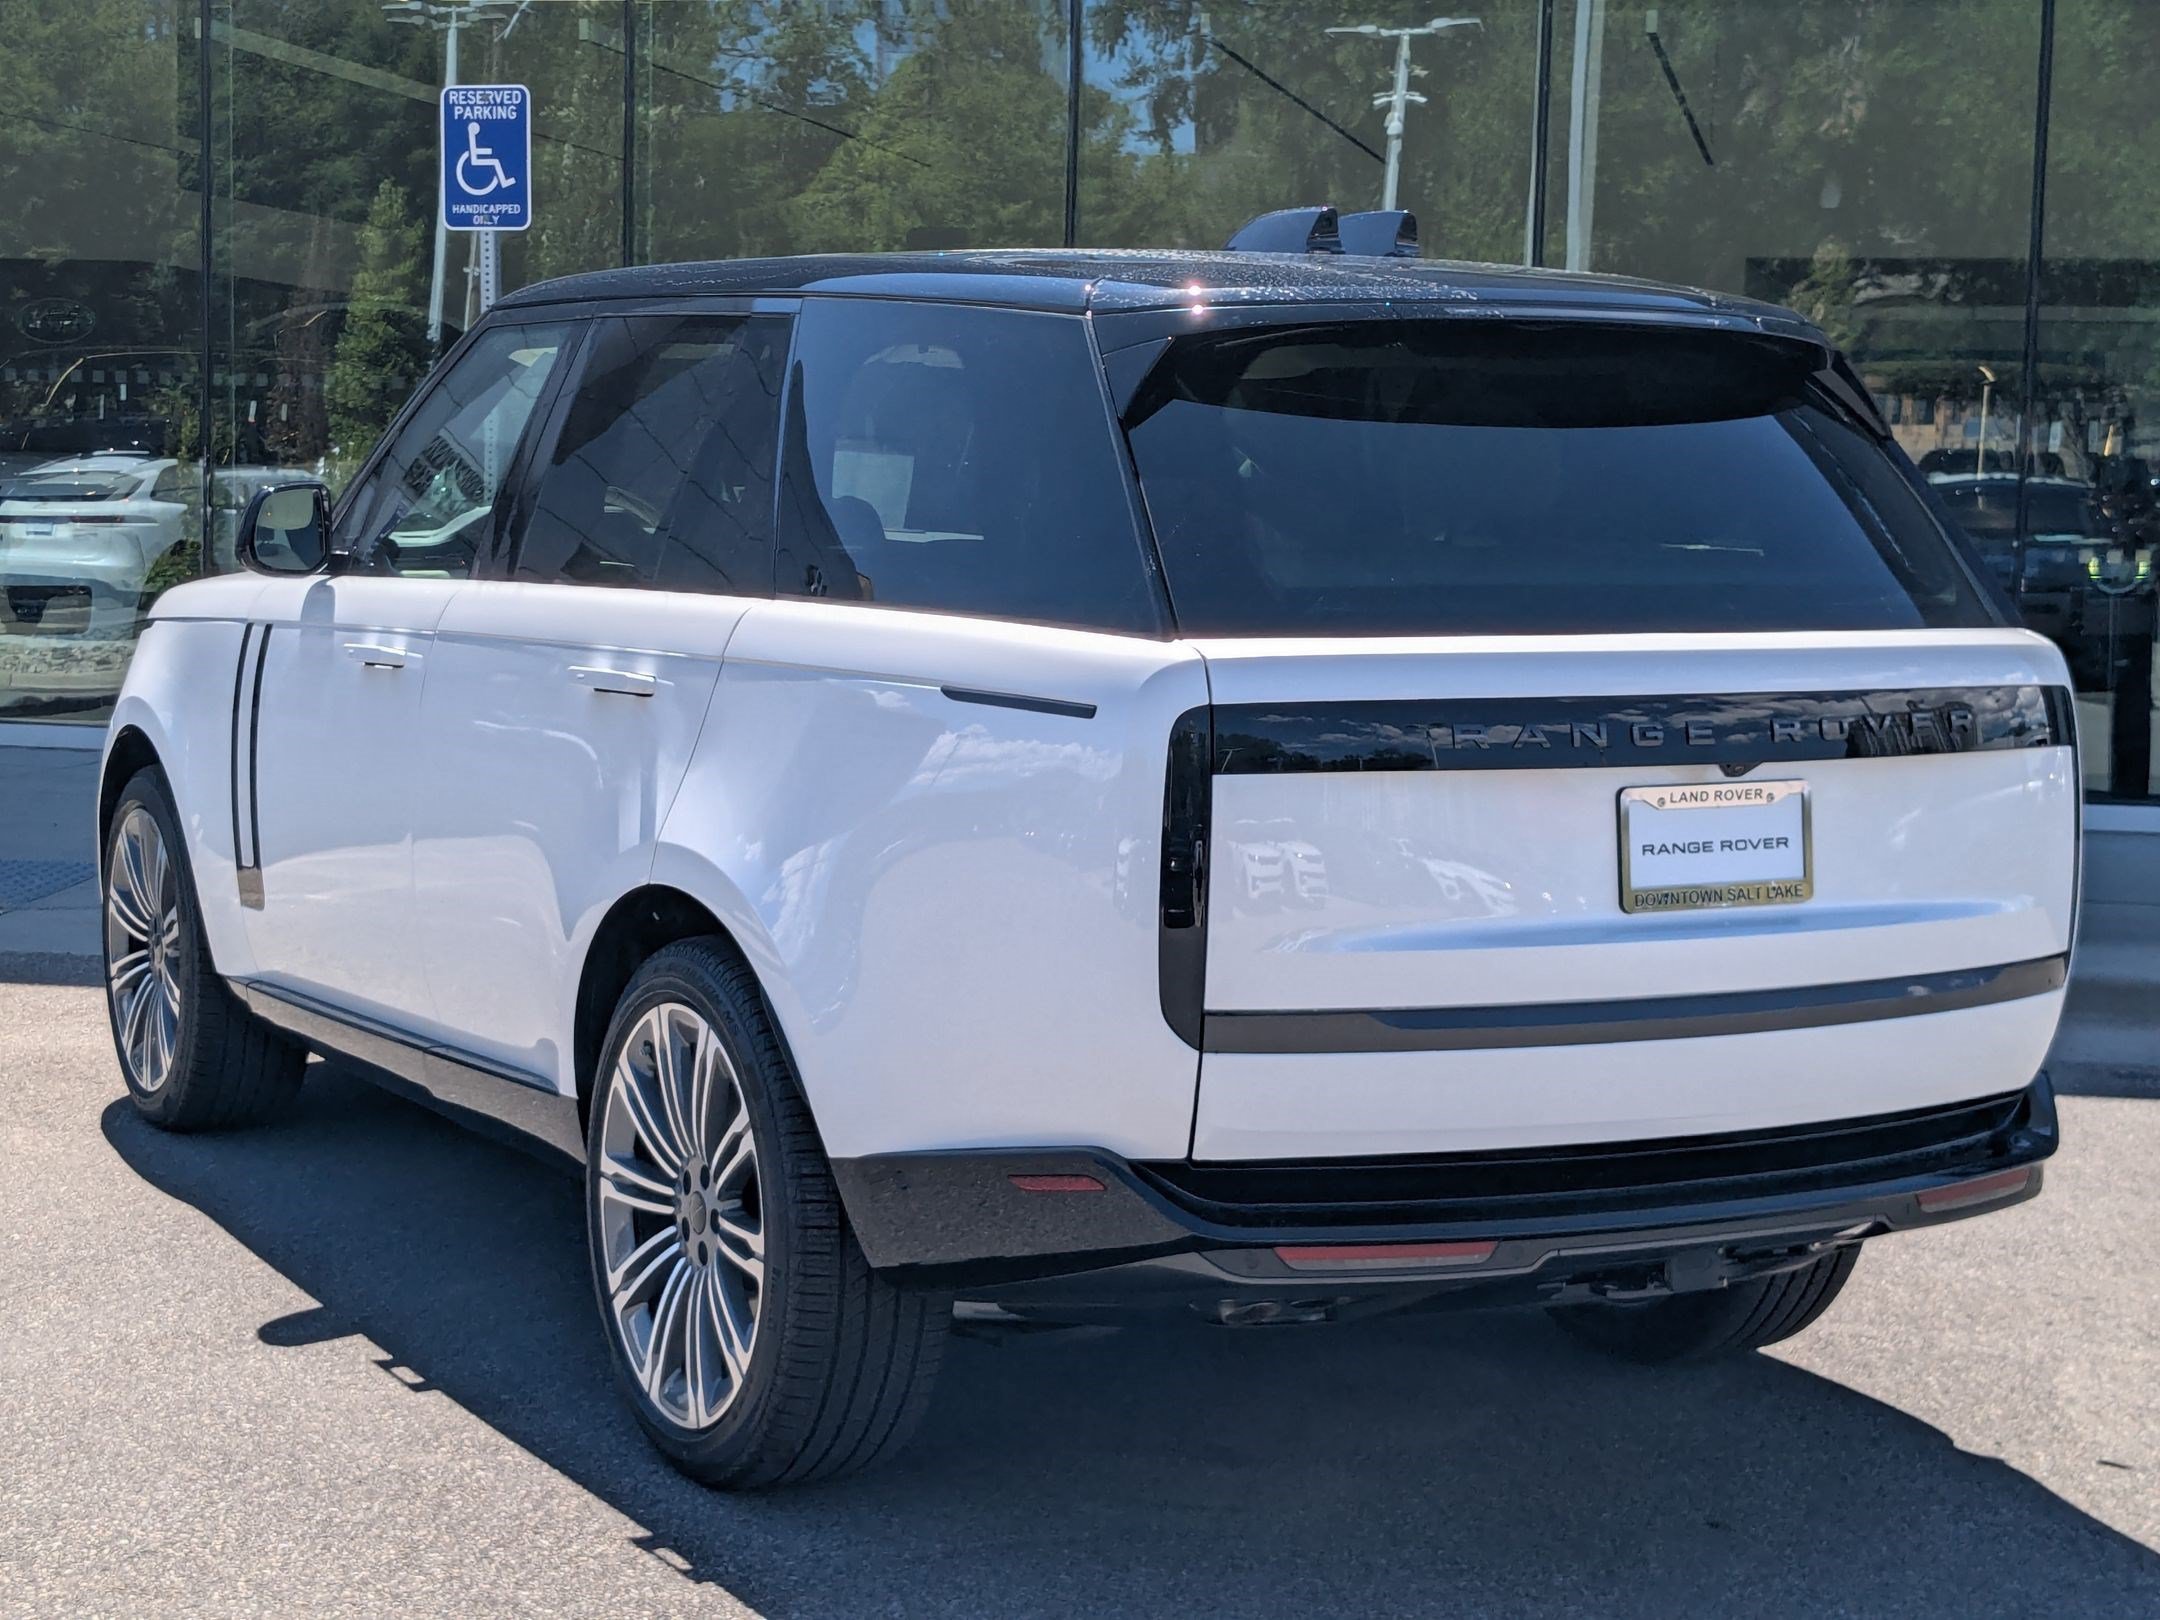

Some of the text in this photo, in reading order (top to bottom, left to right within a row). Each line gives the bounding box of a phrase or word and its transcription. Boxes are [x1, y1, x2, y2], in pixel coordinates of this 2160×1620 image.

[448, 90, 522, 105] RESERVED
[454, 105, 517, 120] PARKING
[452, 203, 521, 214] HANDICAPPED
[1451, 708, 1972, 749] RANGE ROVER
[1669, 788, 1763, 804] LAND ROVER
[1642, 837, 1789, 856] RANGE ROVER
[1635, 883, 1804, 908] DOWNTOWN SALT LAKE
